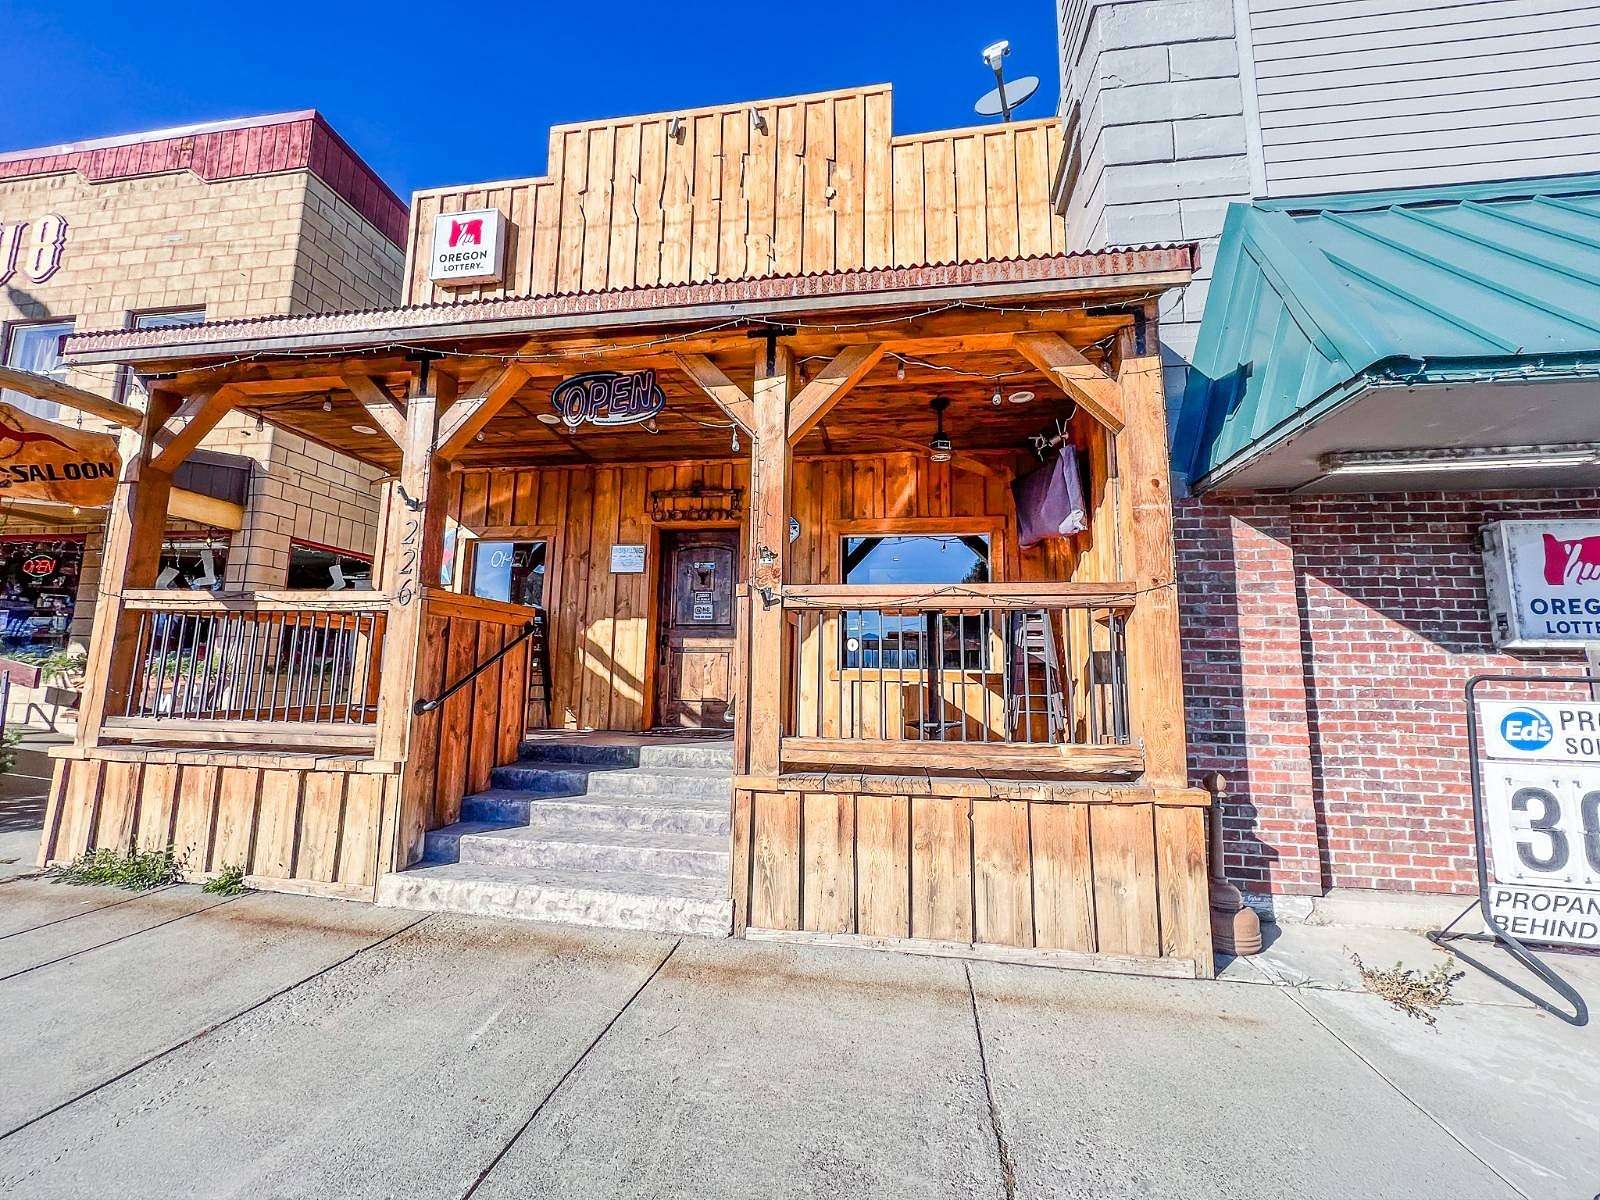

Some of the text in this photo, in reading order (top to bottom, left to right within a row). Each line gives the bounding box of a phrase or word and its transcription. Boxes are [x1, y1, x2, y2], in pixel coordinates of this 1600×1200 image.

[439, 250, 488, 263] OREGON
[563, 370, 654, 424] OPEN
[9, 462, 114, 482] SALOON
[399, 519, 419, 606] 226
[1493, 914, 1598, 939] BEHIND
